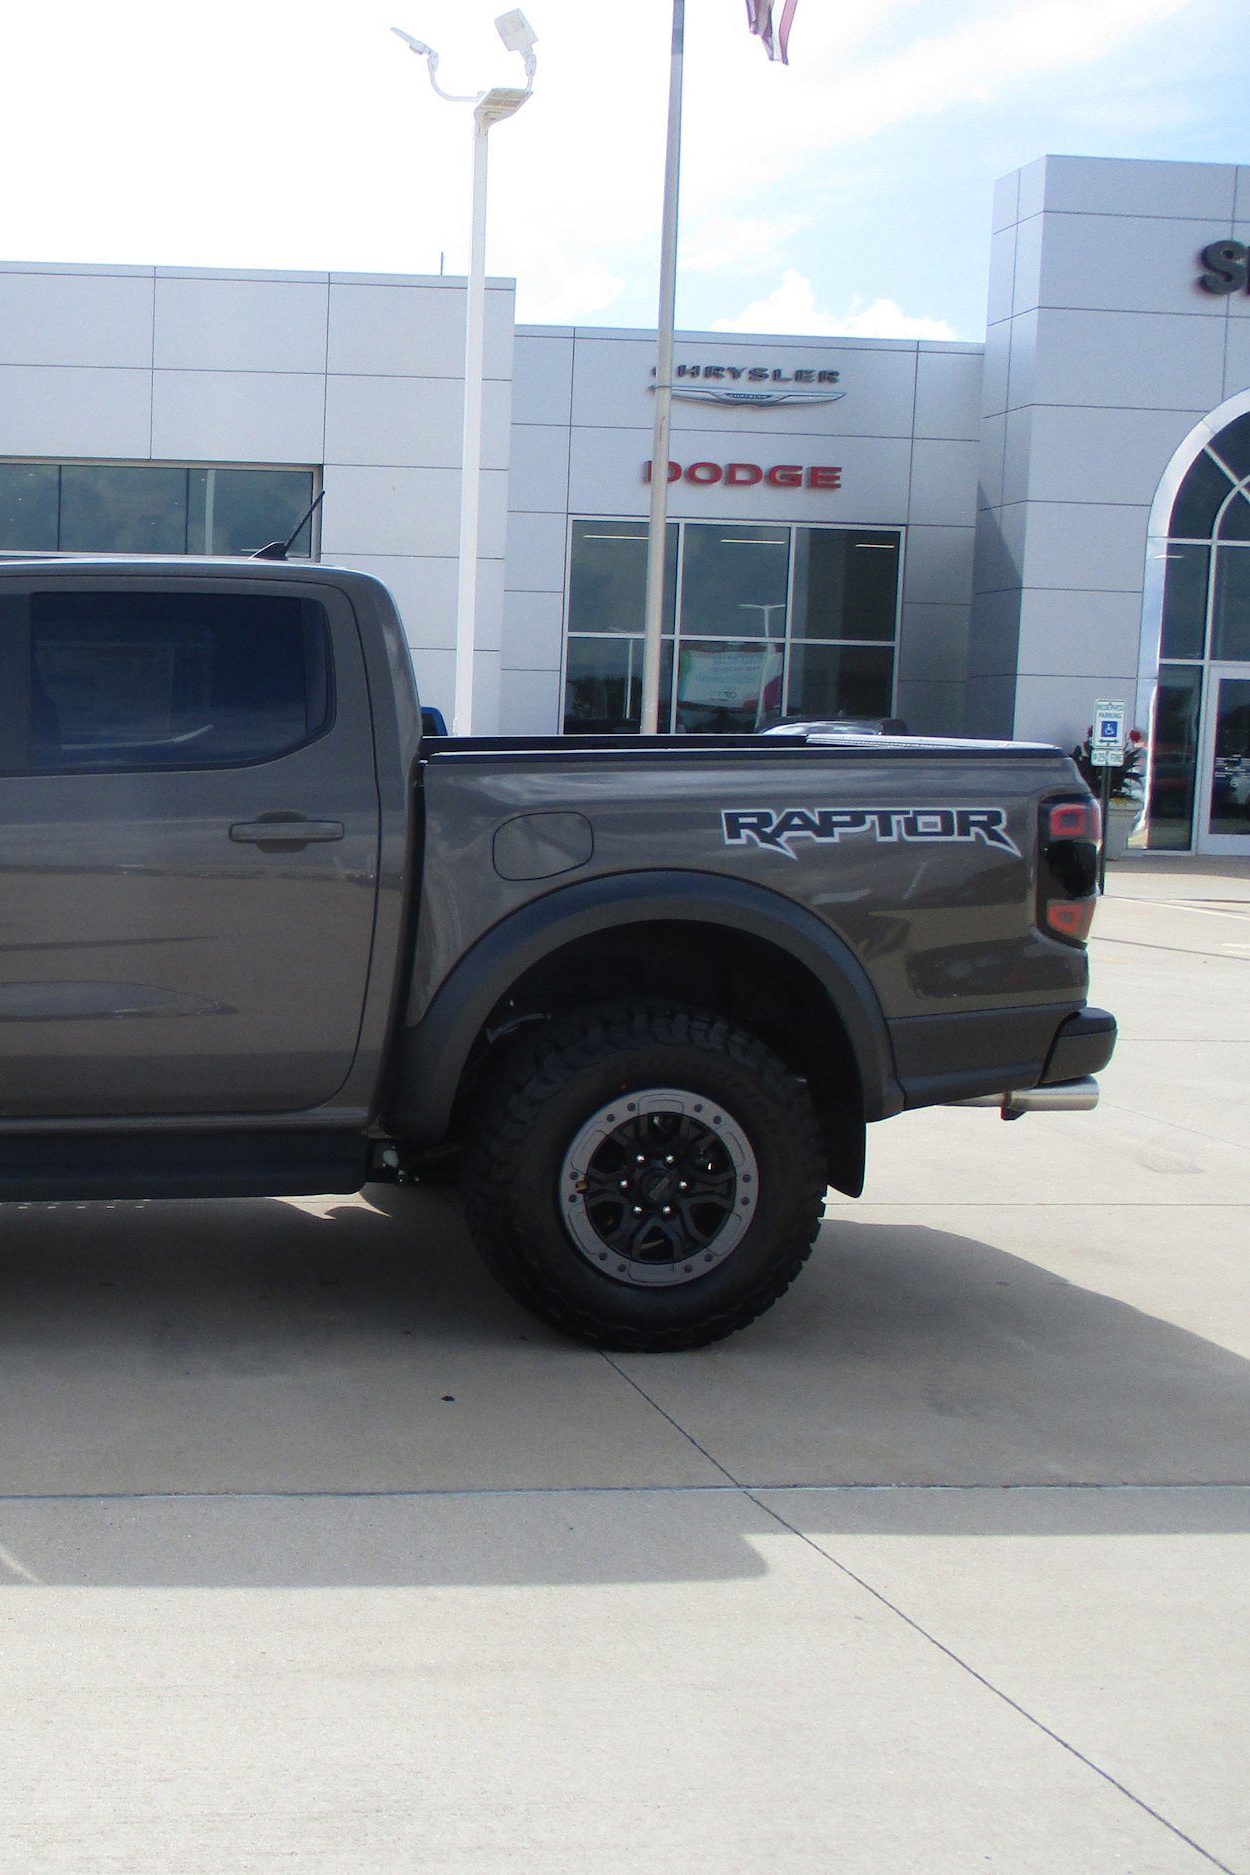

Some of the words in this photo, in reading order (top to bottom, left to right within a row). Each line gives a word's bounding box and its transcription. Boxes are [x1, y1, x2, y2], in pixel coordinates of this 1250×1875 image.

[1197, 240, 1250, 296] S
[652, 364, 840, 384] HRYSLER
[643, 459, 842, 490] DODGE
[721, 807, 1022, 861] RAPTOR
